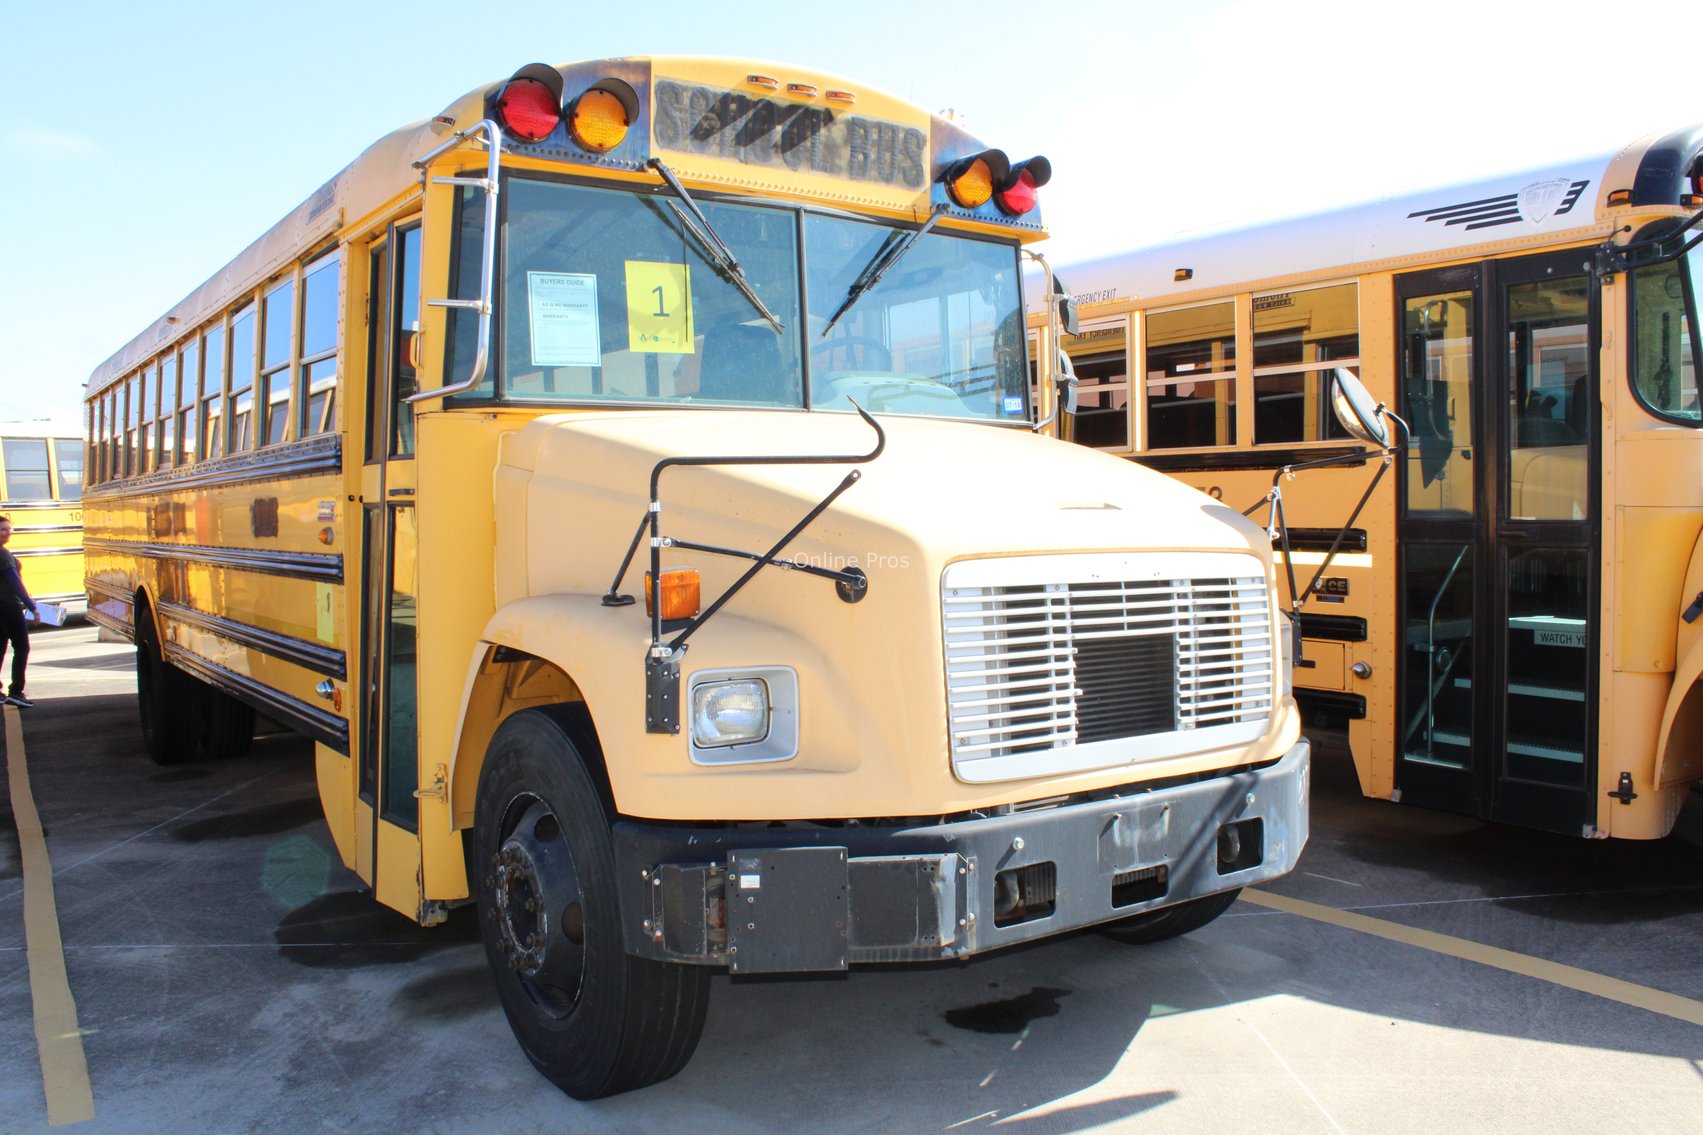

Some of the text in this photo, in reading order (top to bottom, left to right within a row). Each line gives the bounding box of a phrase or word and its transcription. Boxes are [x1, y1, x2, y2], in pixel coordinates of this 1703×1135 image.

[850, 115, 925, 188] BUS
[651, 285, 670, 317] 1
[1102, 288, 1117, 301] EXIT
[69, 511, 84, 522] 10
[1540, 632, 1573, 645] WATCH
